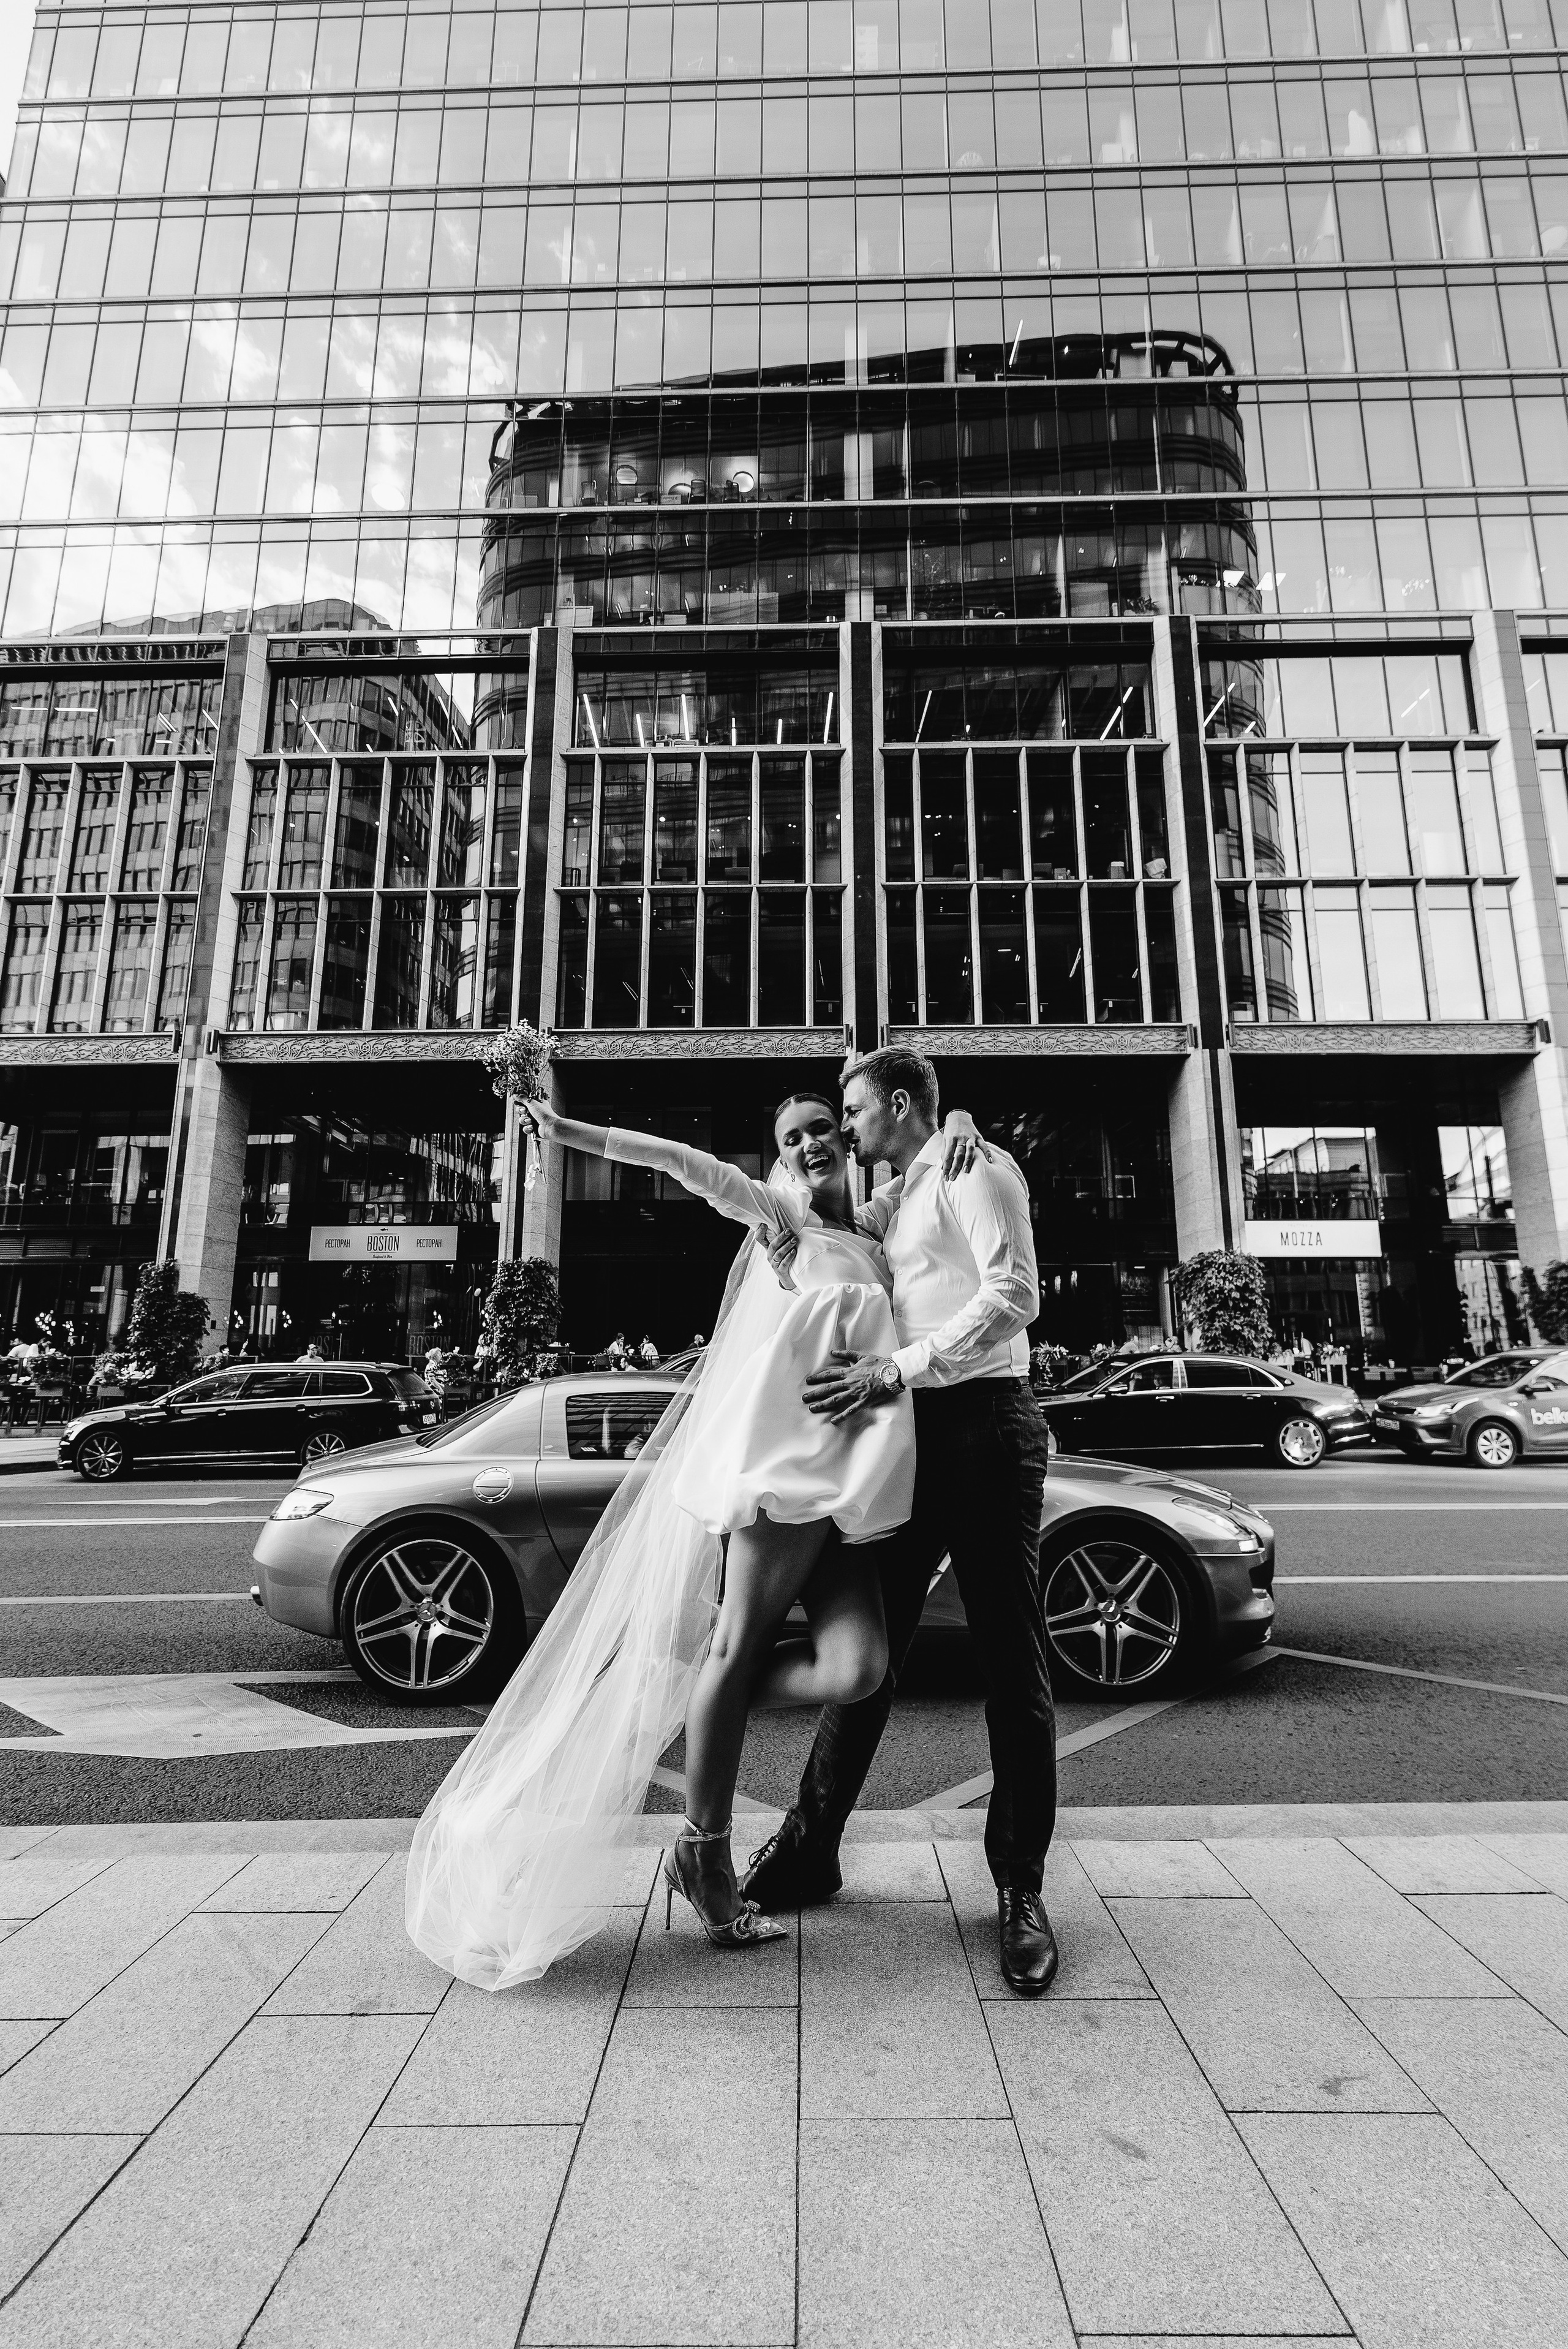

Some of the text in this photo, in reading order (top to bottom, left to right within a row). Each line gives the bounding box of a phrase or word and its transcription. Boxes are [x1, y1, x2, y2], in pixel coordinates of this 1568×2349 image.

[325, 1238, 351, 1248] РЕСТОРАН
[367, 1235, 399, 1251] BOSTON
[416, 1238, 442, 1248] РЕСТОРАН
[1280, 1231, 1323, 1246] MOZZA
